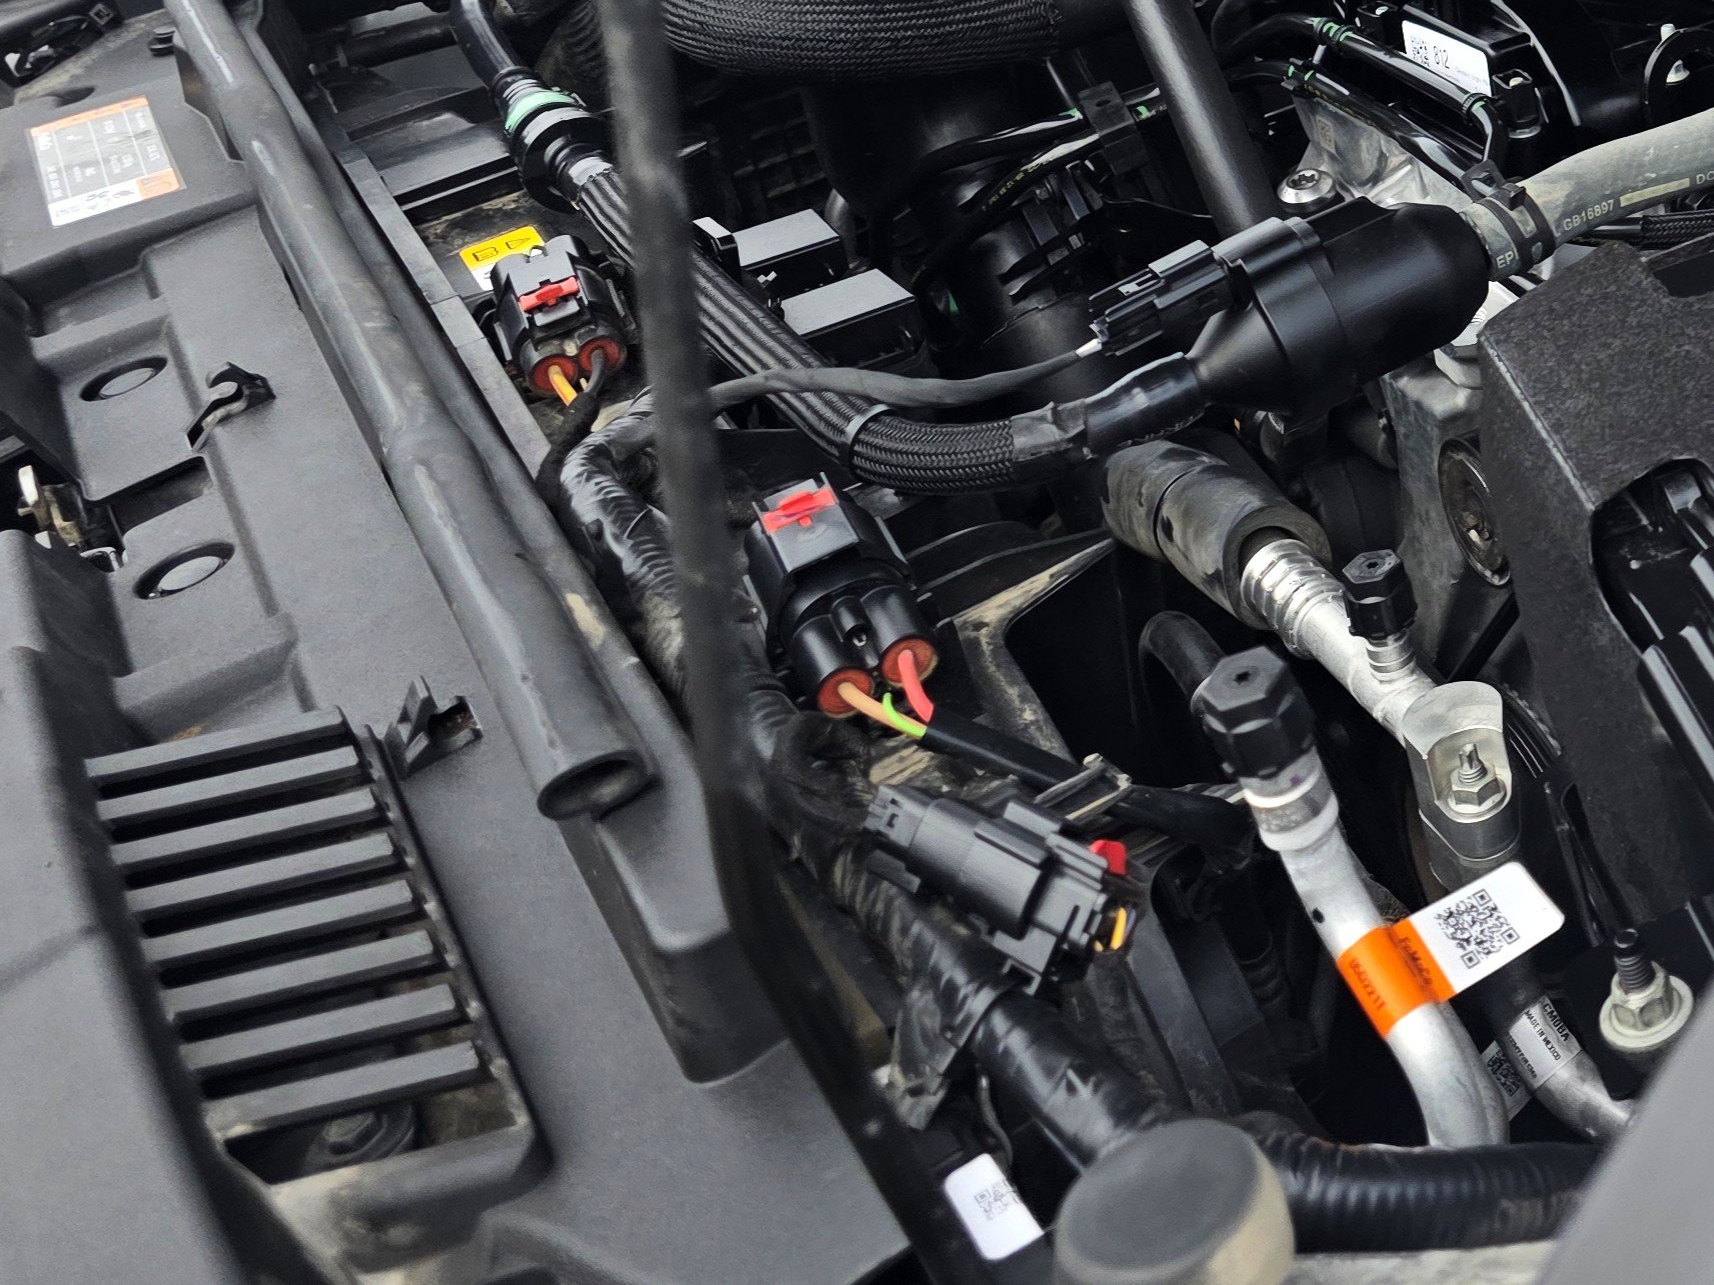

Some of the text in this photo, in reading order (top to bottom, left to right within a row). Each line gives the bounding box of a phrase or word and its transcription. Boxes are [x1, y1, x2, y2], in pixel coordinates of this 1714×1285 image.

[1432, 45, 1451, 70] 812
[1562, 199, 1615, 232] GB16897
[1524, 1009, 1539, 1030] MADE
[1541, 1035, 1562, 1062] MEXICO
